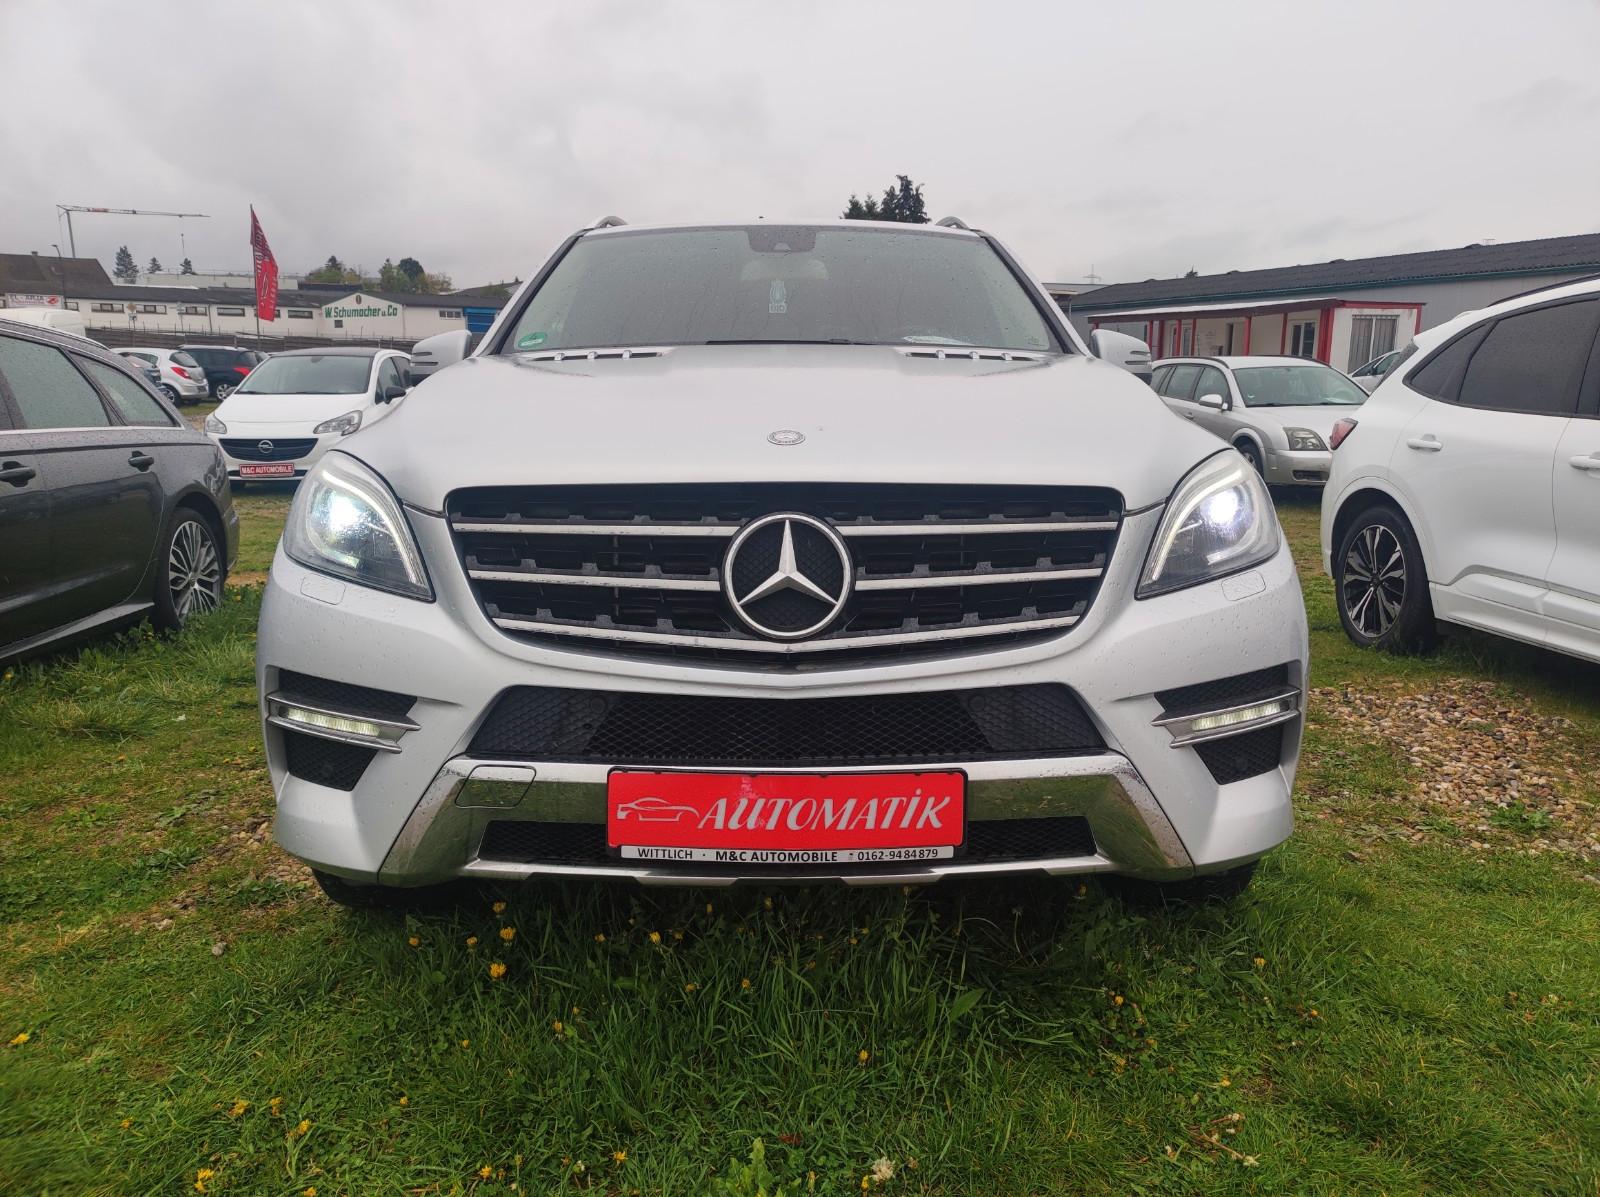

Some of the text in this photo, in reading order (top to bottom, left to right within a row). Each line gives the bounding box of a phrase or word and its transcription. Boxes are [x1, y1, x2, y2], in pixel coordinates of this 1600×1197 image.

[334, 305, 381, 318] Schumacher
[255, 465, 292, 474] AUTOMOBILE
[637, 848, 938, 863] WITTLICH M&C AUTOMOBILE 0162-9484879
